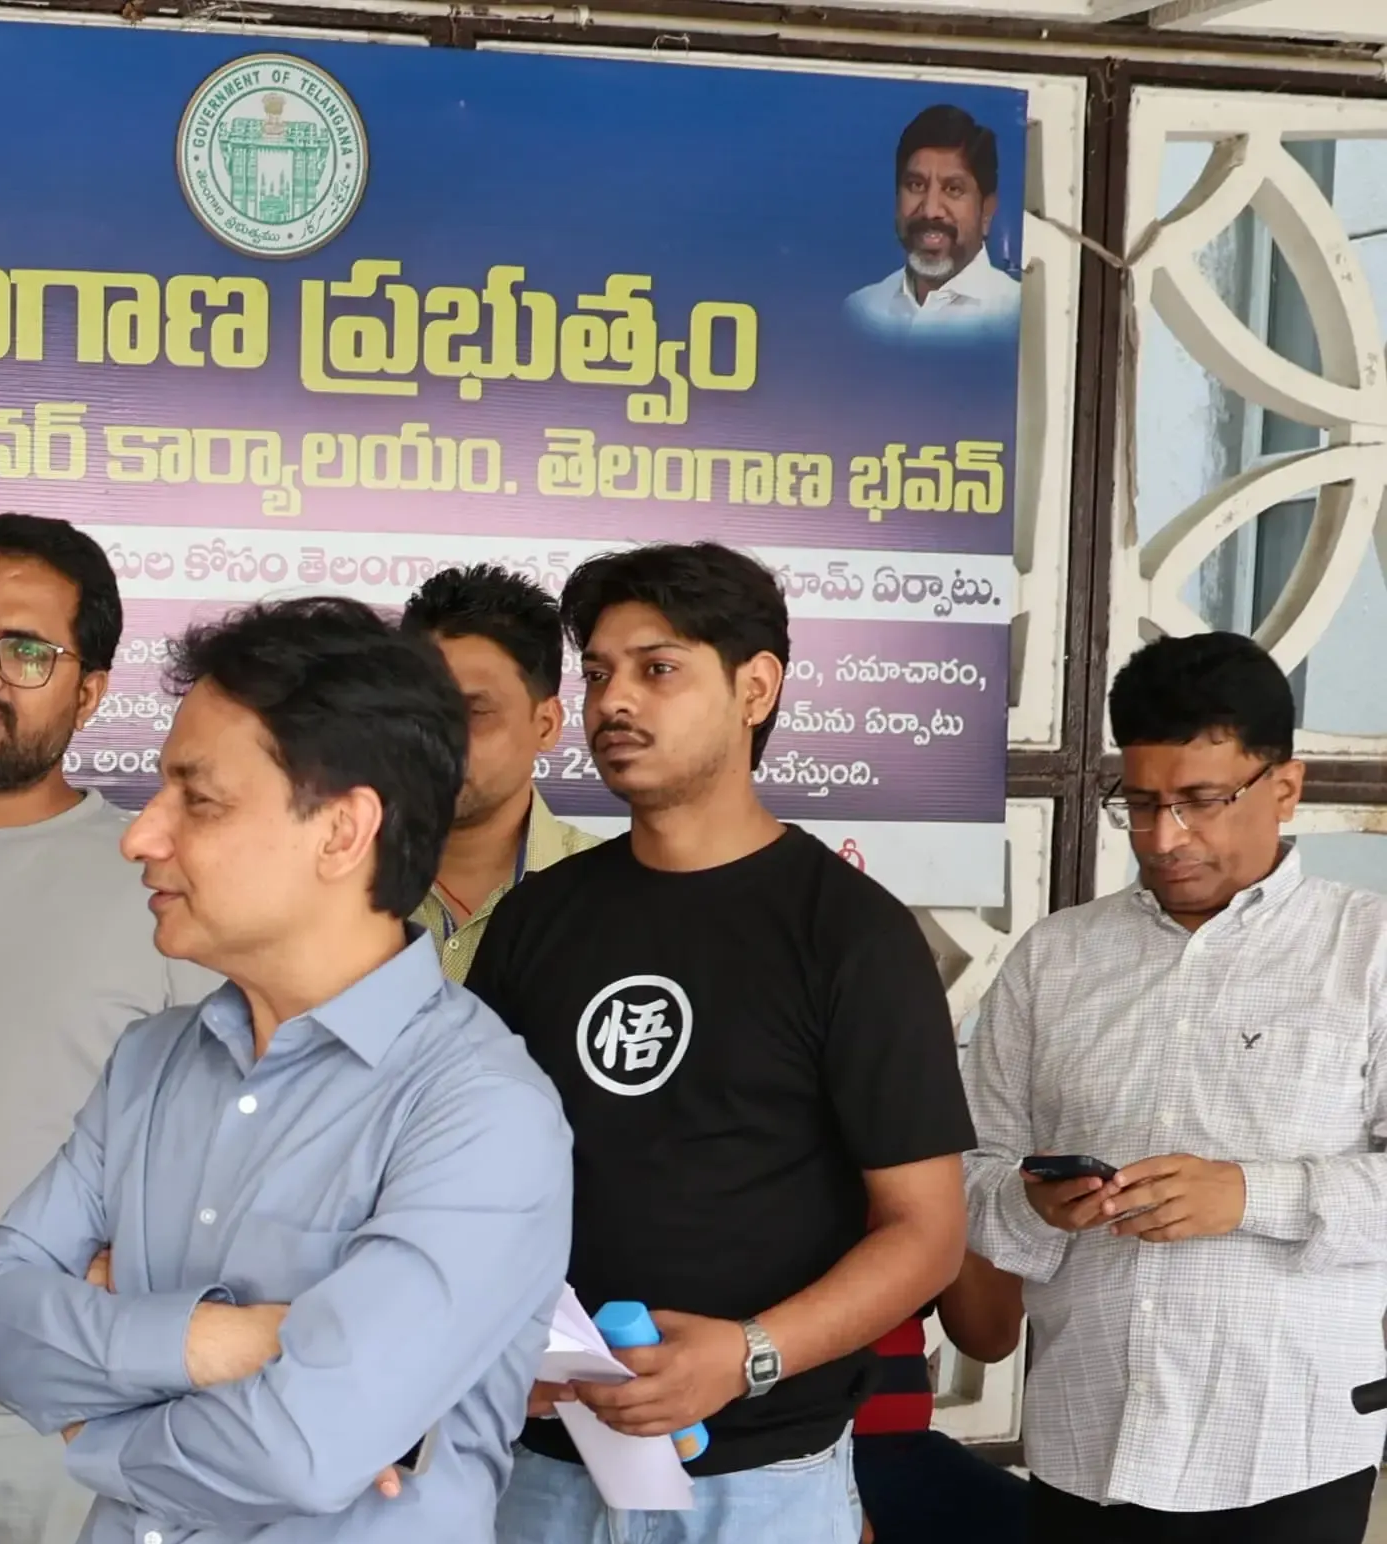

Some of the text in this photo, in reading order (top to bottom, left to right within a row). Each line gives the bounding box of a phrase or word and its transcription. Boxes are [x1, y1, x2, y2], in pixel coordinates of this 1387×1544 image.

[193, 69, 354, 156] GOVERNMENT OF TELANGANA
[300, 259, 758, 425] ప్రభుత్వం
[538, 428, 833, 508] తెలంగాణ
[849, 441, 1004, 522] భవన్
[184, 537, 289, 584] కోసం
[593, 999, 674, 1072] 悟
